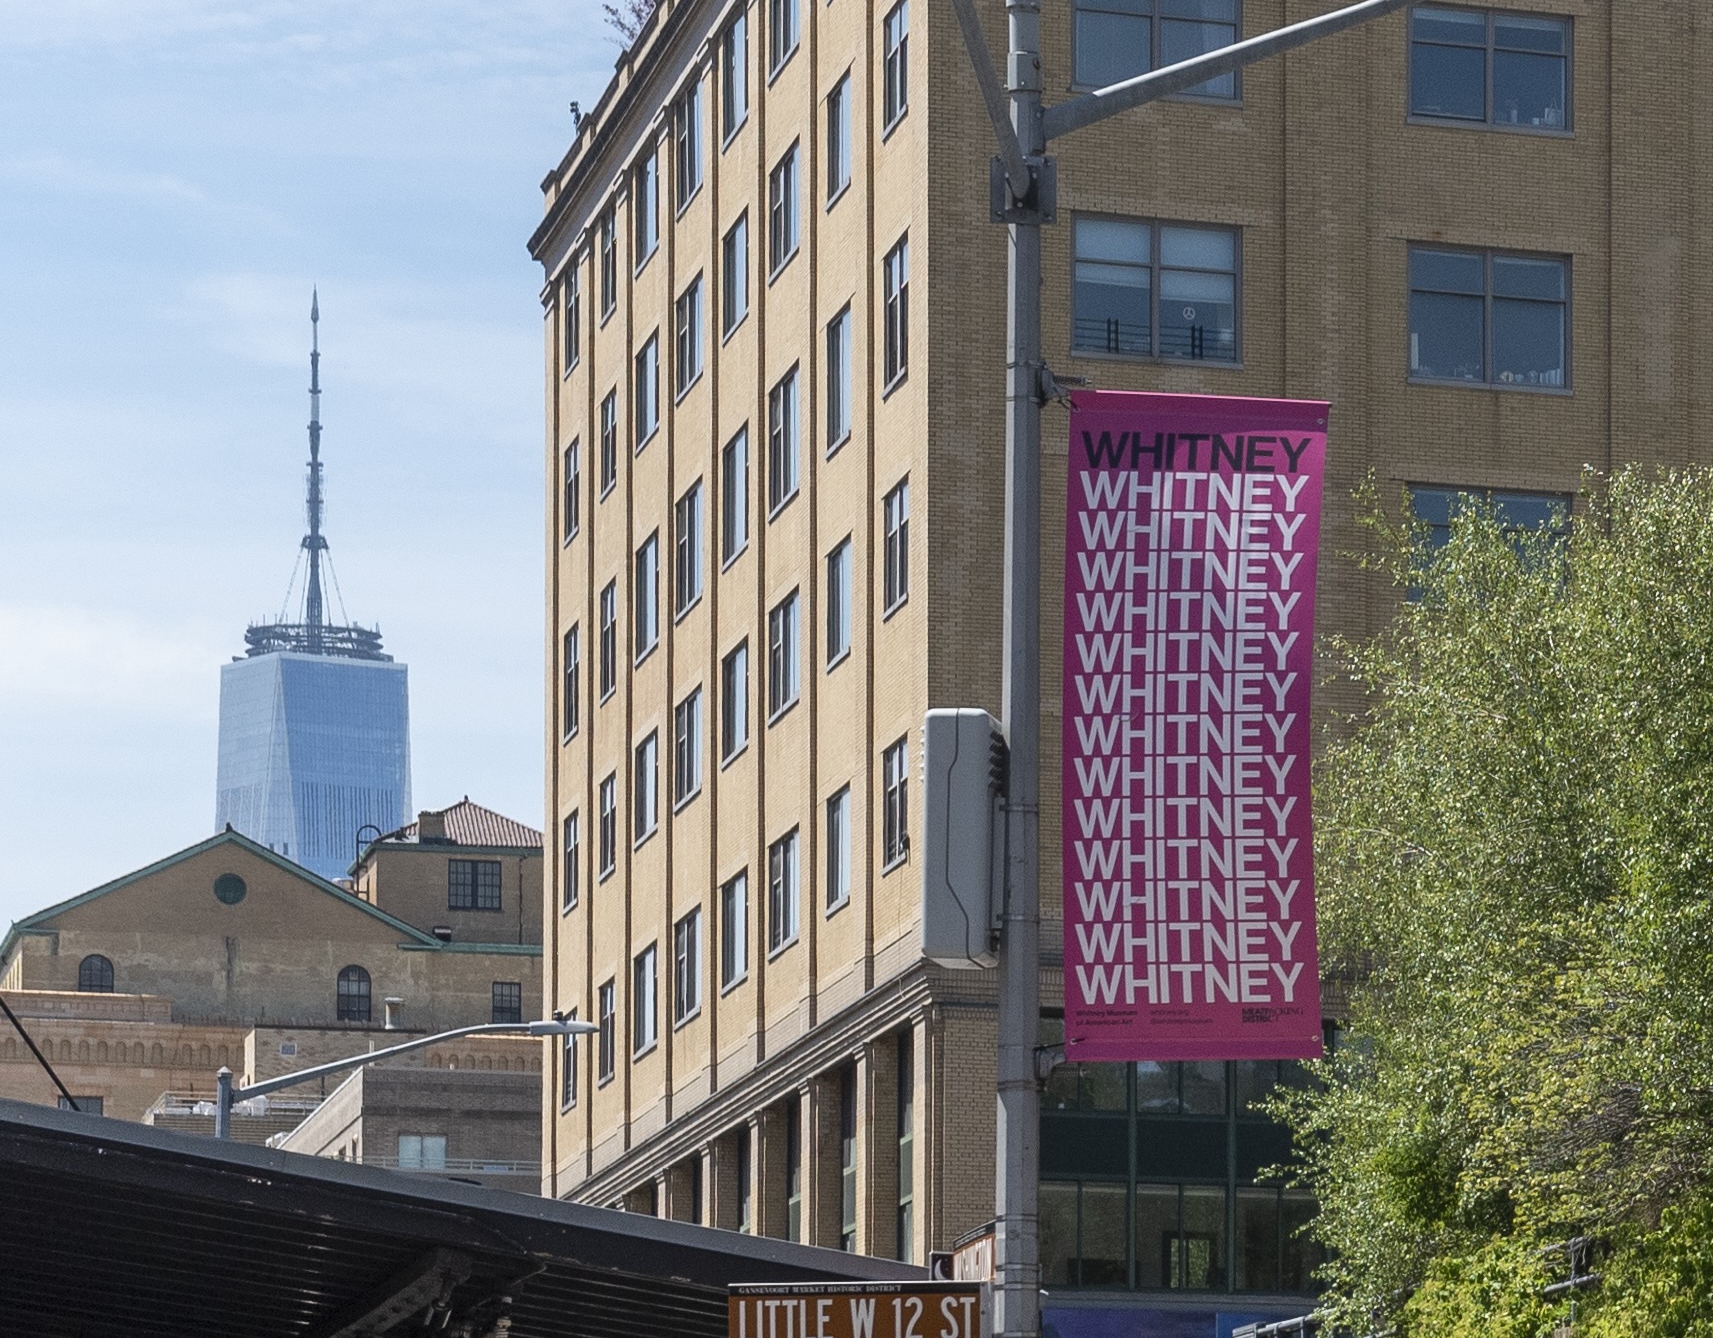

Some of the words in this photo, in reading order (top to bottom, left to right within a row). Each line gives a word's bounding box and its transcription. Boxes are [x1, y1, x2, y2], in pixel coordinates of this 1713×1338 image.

[1082, 431, 1311, 473] WHITNEY
[1080, 471, 1309, 512] WHITNEY
[1078, 511, 1307, 551] WHITNEY
[1077, 551, 1304, 591] WHITNEY
[1076, 592, 1301, 632] WHITNEY
[1075, 632, 1299, 674] WHITNEY
[1074, 672, 1298, 714] WHITNEY
[1074, 713, 1297, 755] WHITNEY
[1074, 755, 1297, 797] WHITNEY
[1074, 796, 1298, 839] WHITNEY
[1074, 838, 1299, 880] WHITNEY
[1074, 880, 1300, 922] WHITNEY
[1074, 921, 1302, 963] WHITNEY
[1075, 963, 1304, 1005] WHITNEY
[792, 1285, 825, 1293] MARKET
[827, 1285, 863, 1293] HISTORIC
[866, 1284, 902, 1293] DISTRICT
